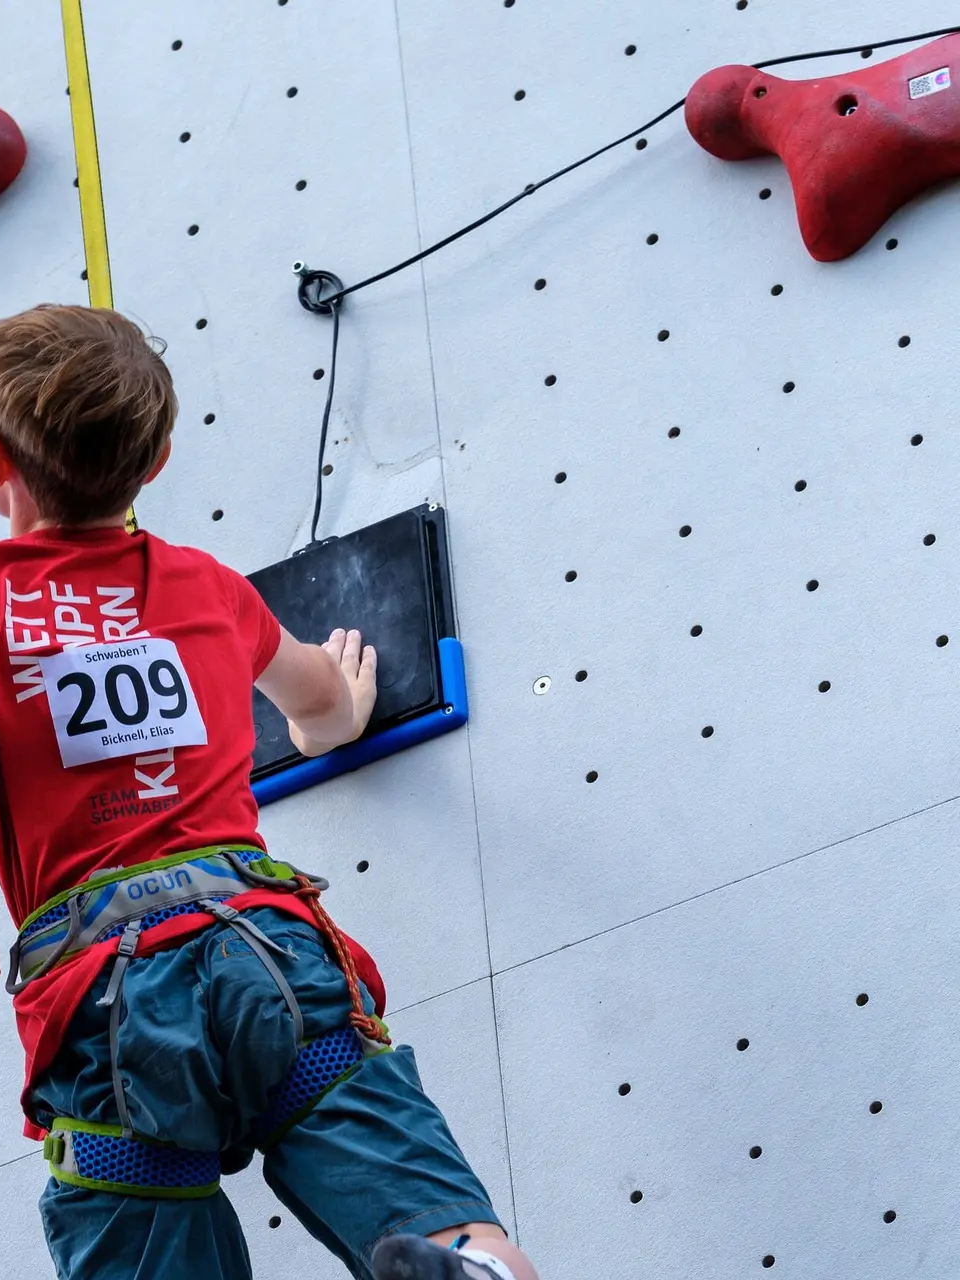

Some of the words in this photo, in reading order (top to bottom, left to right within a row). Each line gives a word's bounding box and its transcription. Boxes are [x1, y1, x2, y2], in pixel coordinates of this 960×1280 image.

[5, 577, 50, 704] WETT
[85, 648, 140, 663] Schwaben
[141, 644, 148, 655] T
[56, 658, 188, 737] 209
[101, 729, 148, 747] Bicknell,
[149, 725, 175, 738] Elias
[89, 787, 137, 810] TEAM
